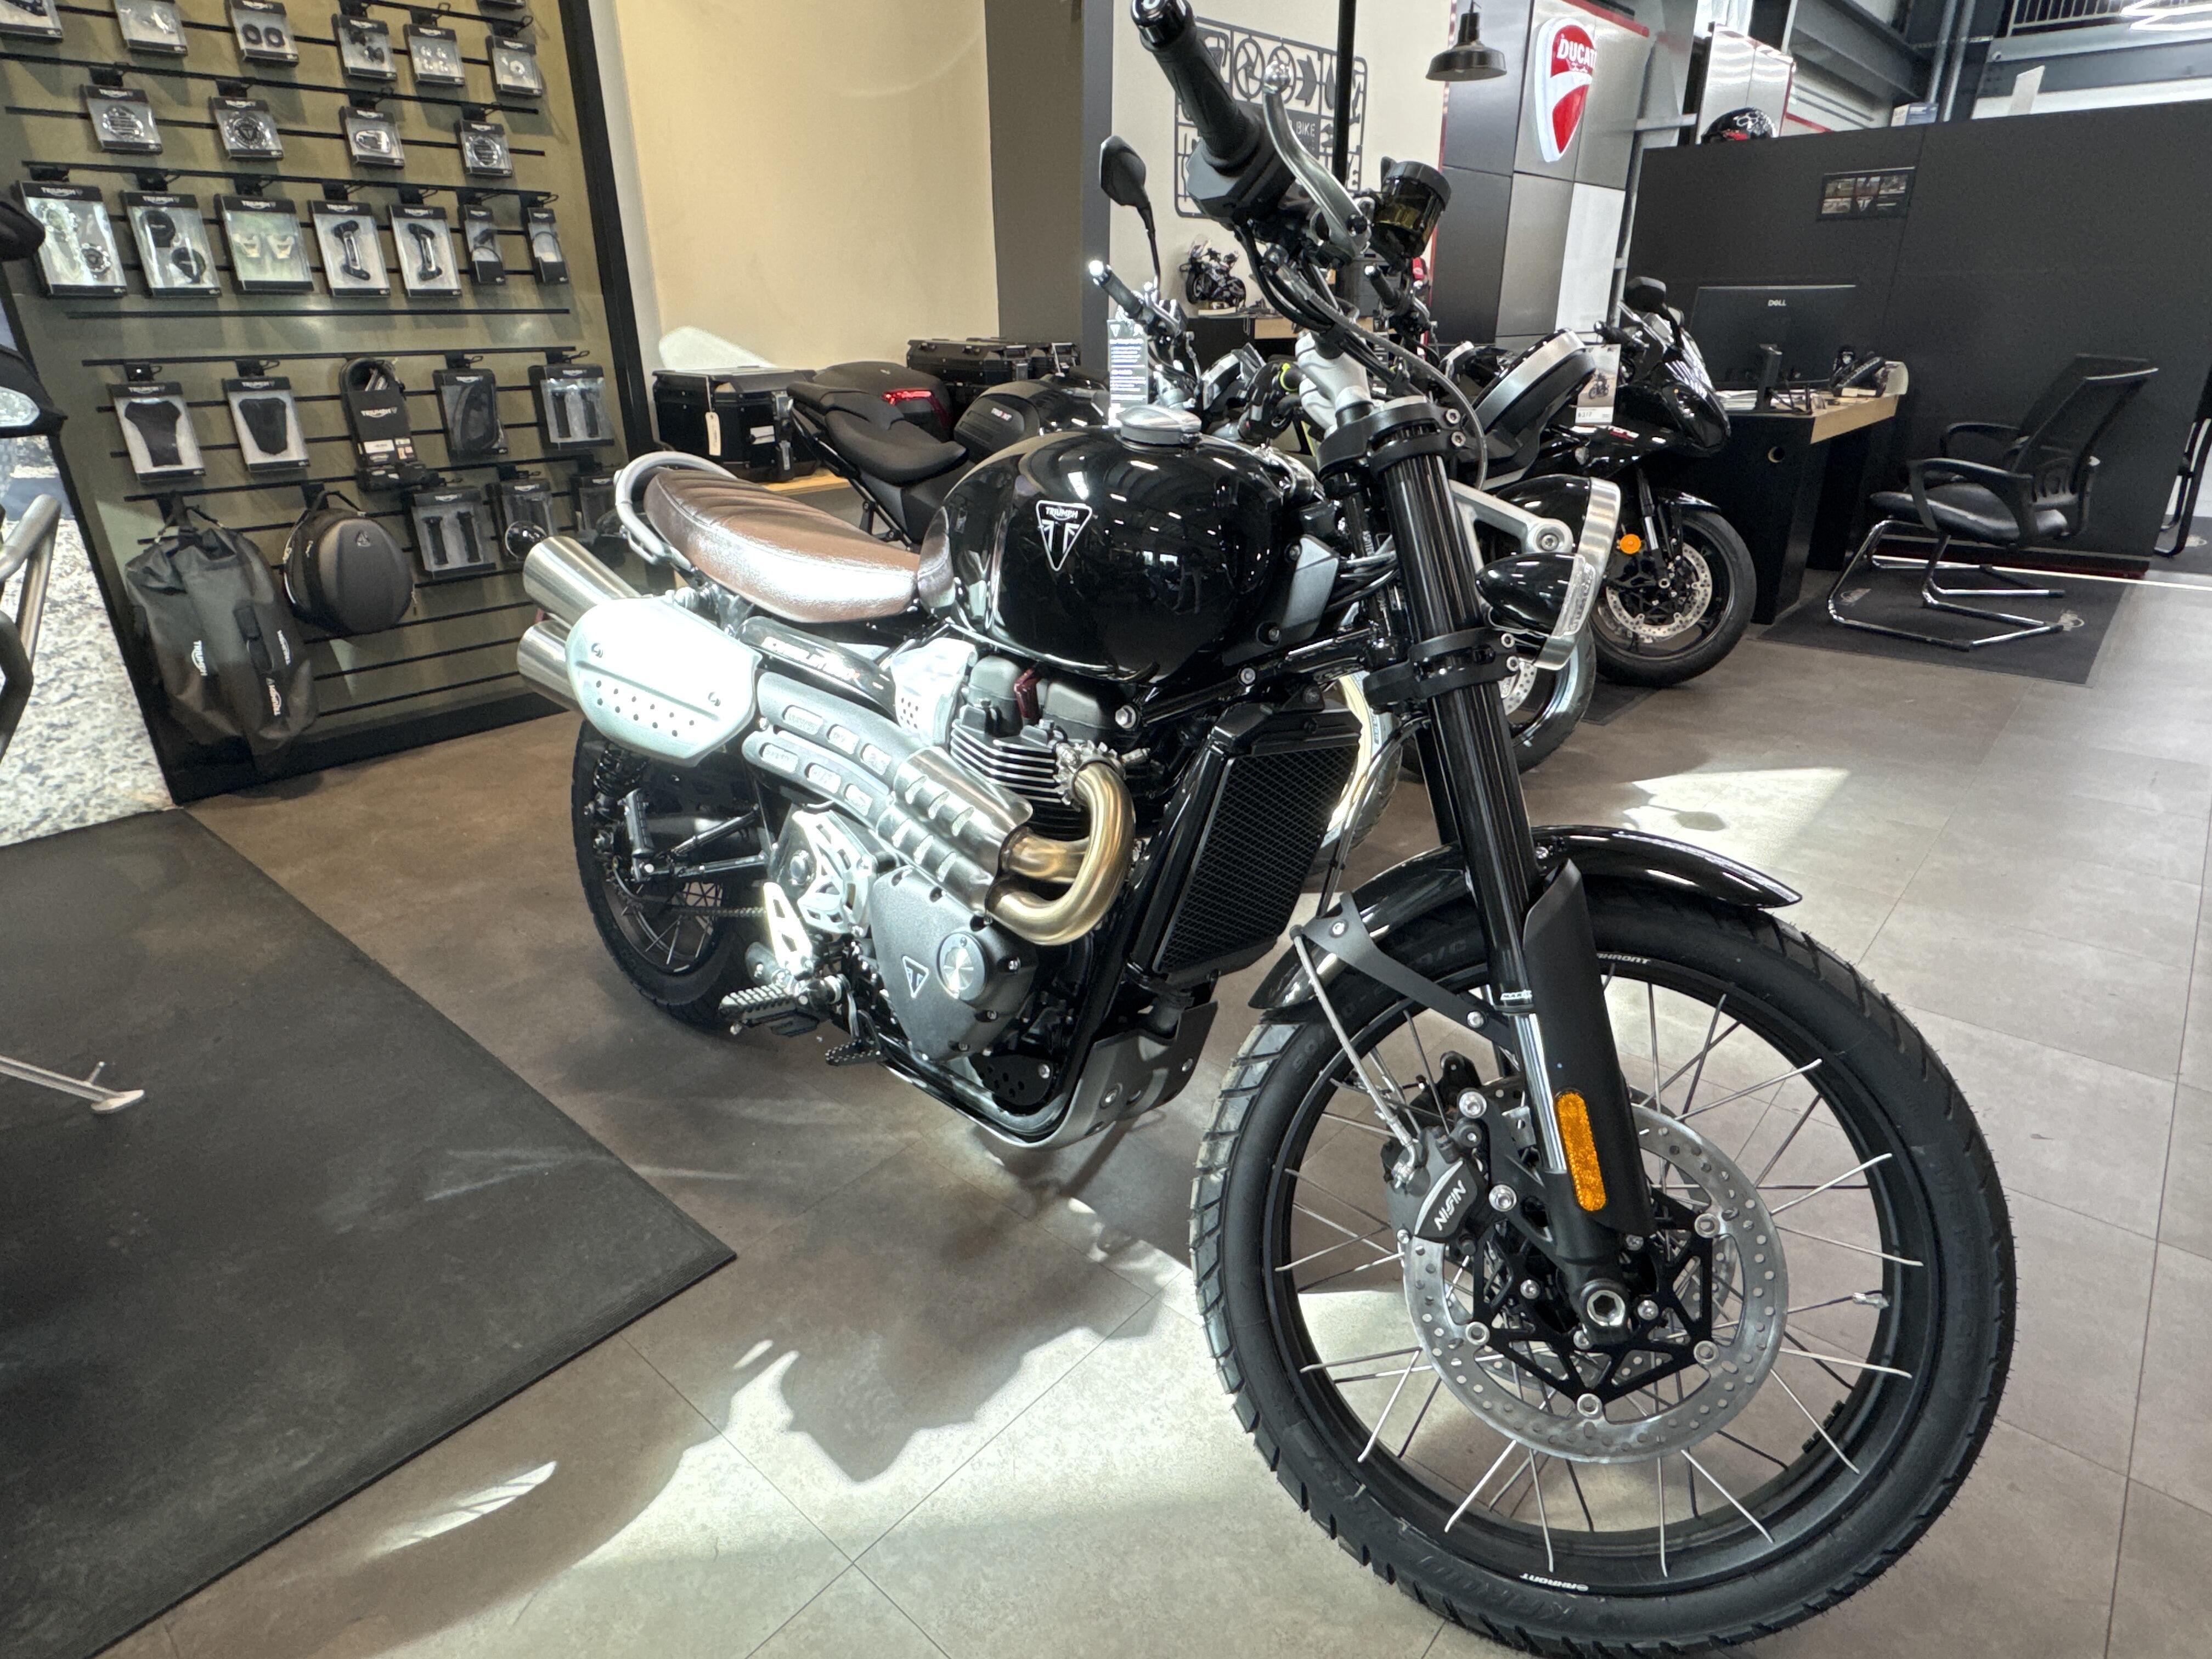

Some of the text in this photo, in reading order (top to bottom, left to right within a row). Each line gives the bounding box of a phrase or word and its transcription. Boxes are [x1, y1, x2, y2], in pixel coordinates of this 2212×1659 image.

[1296, 121, 1316, 137] BIKE
[1045, 506, 1079, 521] TRIUMPH
[191, 640, 208, 676] TRIUMPH
[1434, 1180, 1466, 1231] NISSIN
